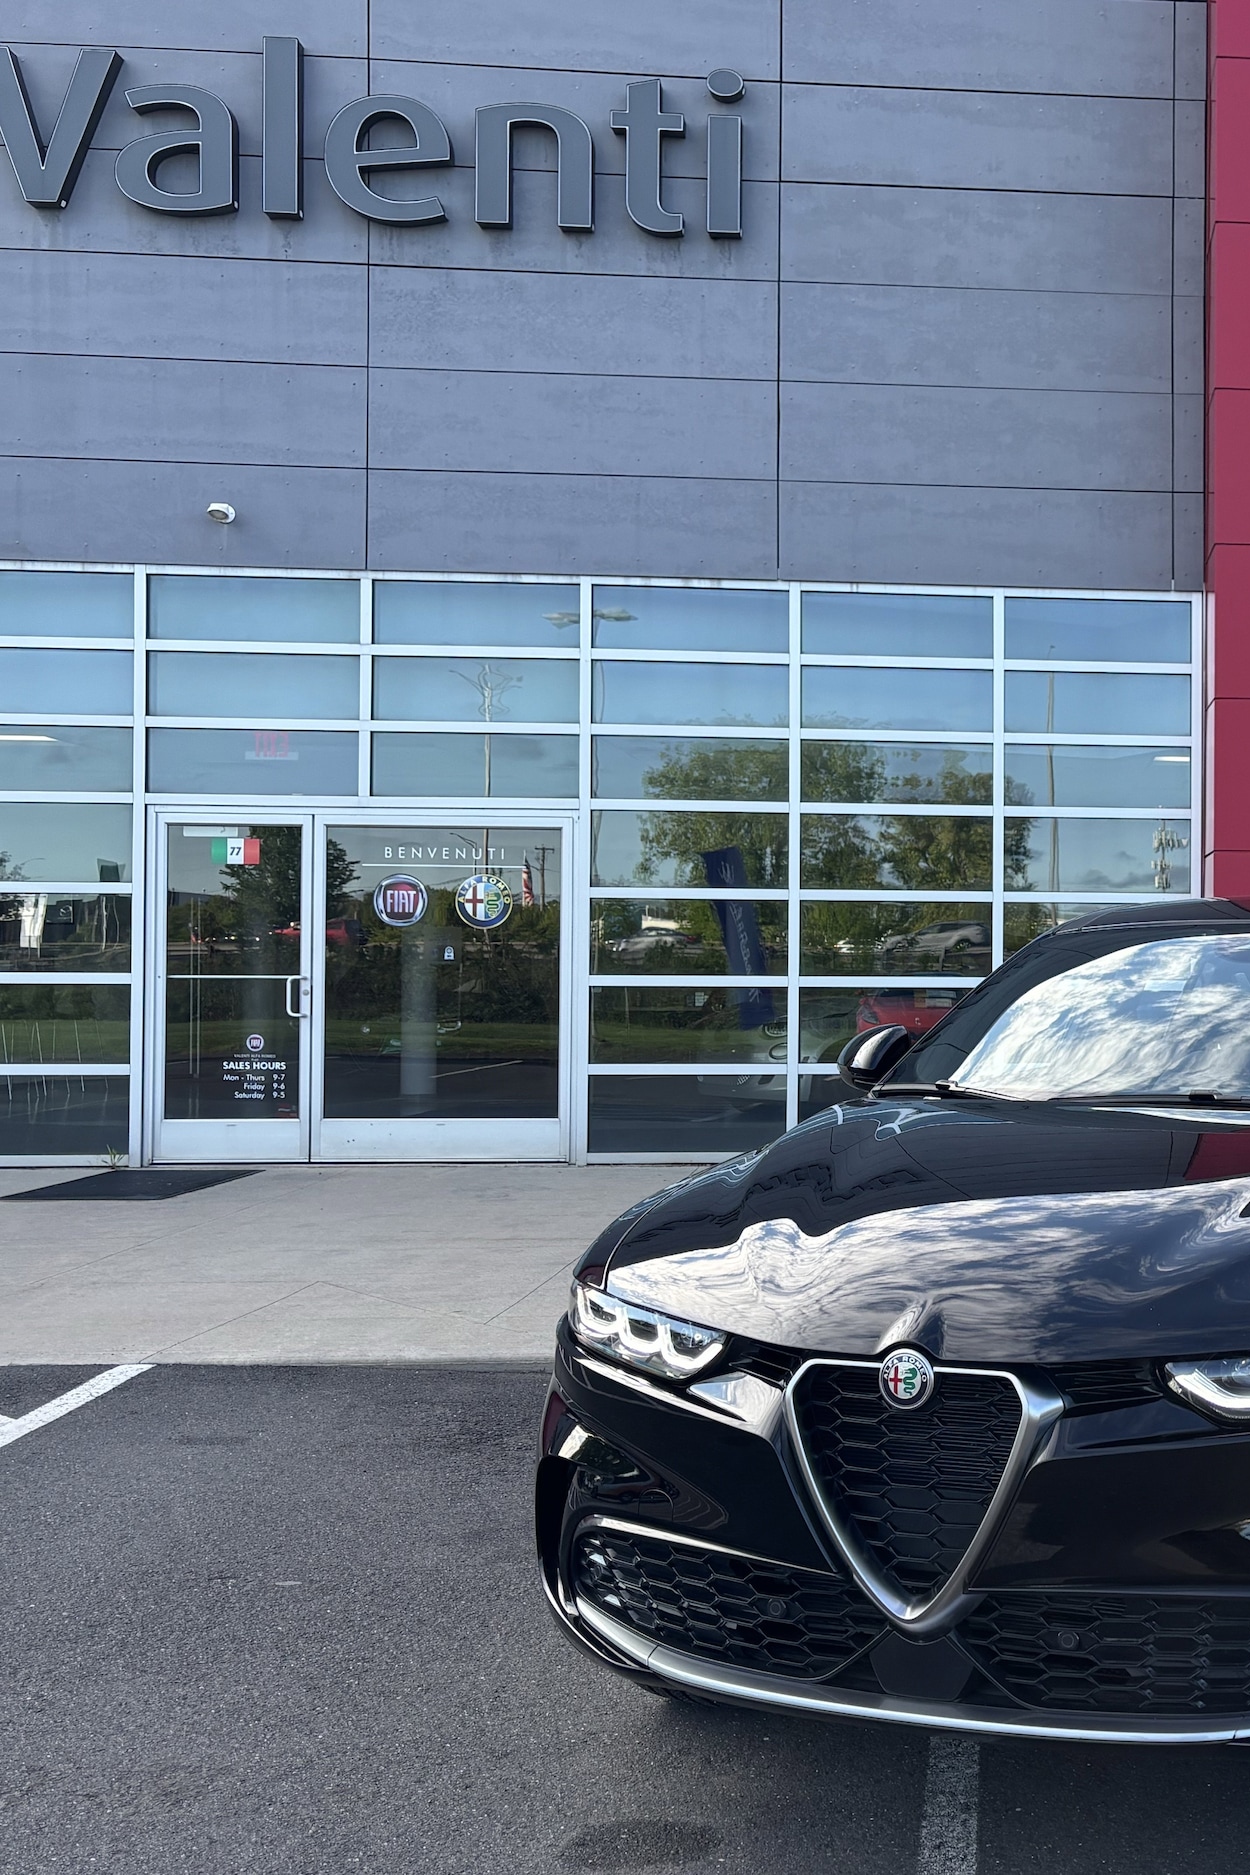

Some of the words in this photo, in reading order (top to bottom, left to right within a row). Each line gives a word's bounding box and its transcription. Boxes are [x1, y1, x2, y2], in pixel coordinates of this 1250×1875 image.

[0, 36, 745, 239] Valenti
[229, 846, 242, 856] 77
[384, 846, 505, 860] BENVENUTI
[458, 879, 478, 903] ALFA
[481, 876, 511, 904] ROMEO
[386, 890, 417, 913] FIAT
[222, 1061, 251, 1070] SALES
[252, 1061, 287, 1070] HOURS
[272, 1073, 286, 1081] 9-7
[243, 1082, 265, 1091] Friday
[272, 1082, 286, 1090] 9-6
[234, 1091, 265, 1100] Saturday
[272, 1091, 286, 1099] 9-5
